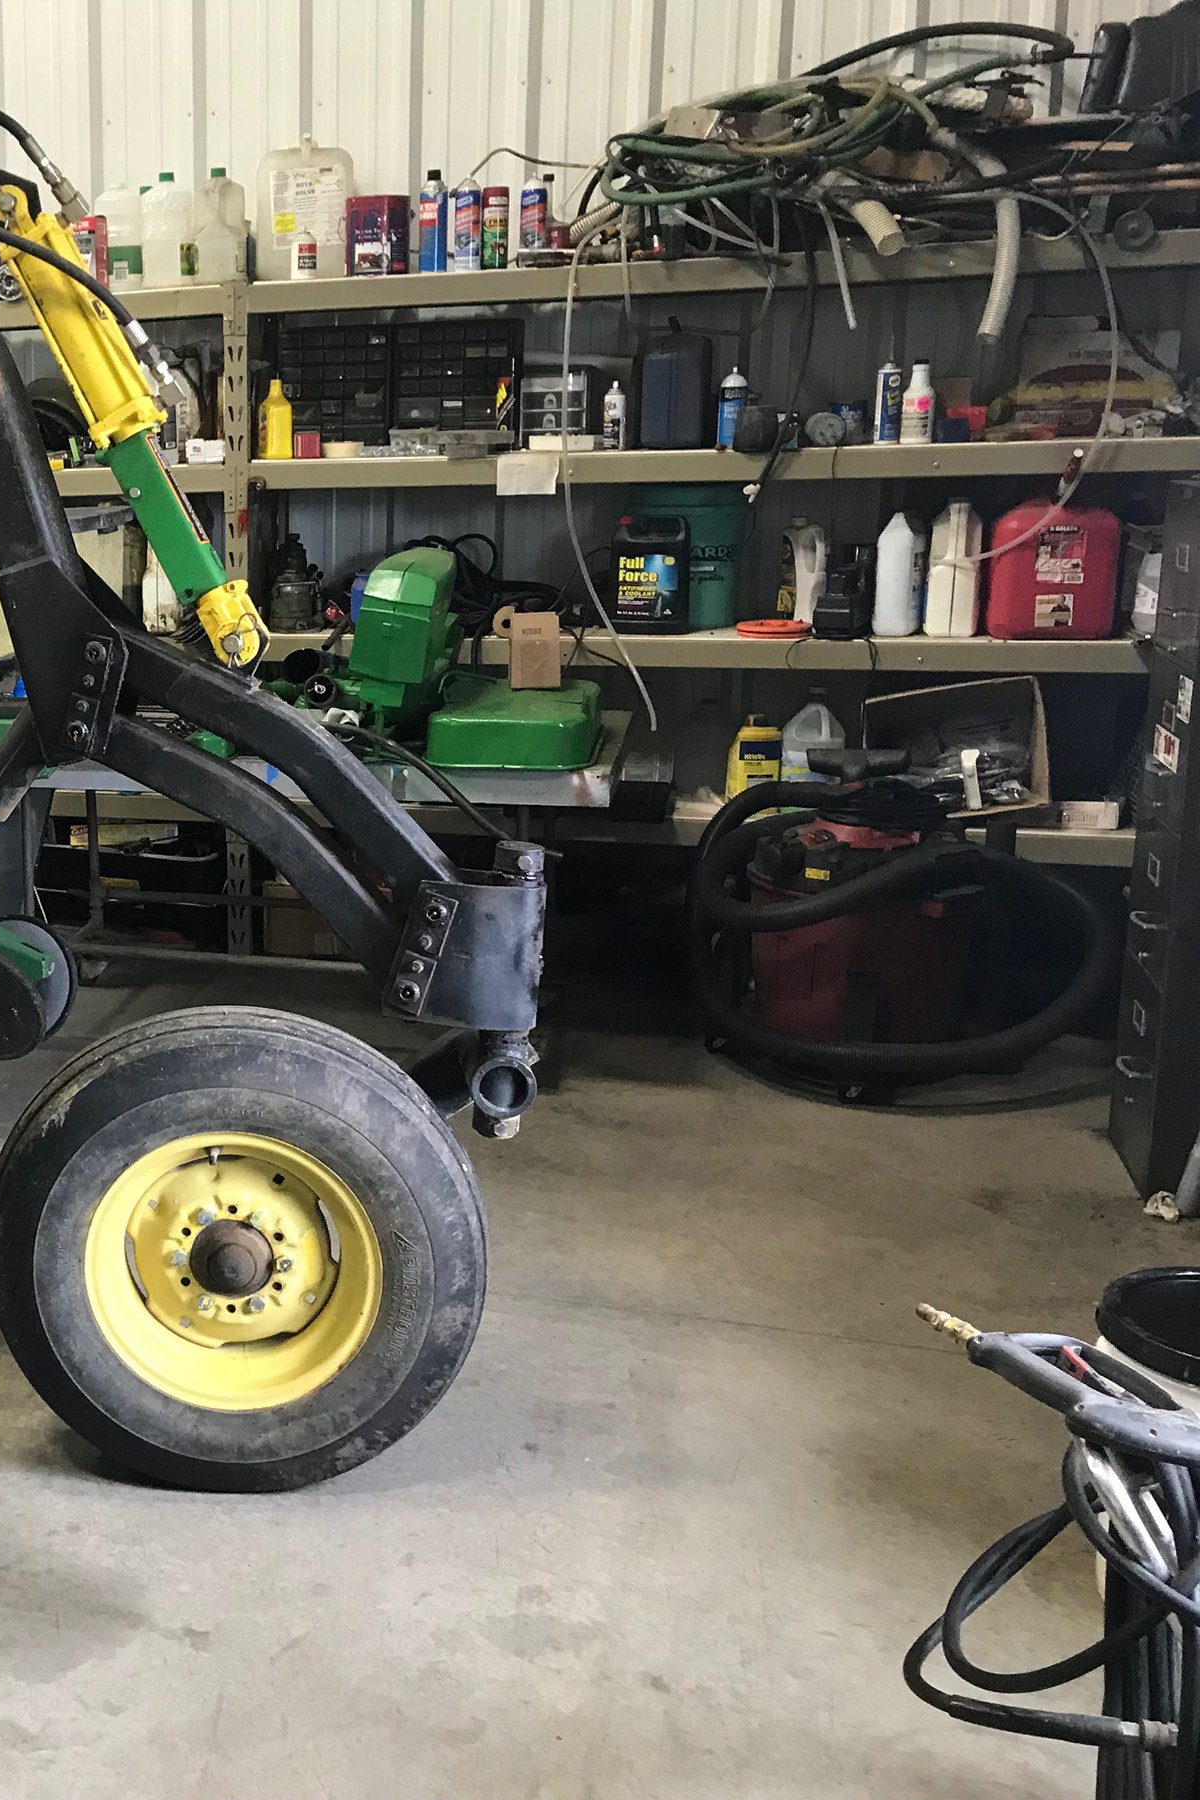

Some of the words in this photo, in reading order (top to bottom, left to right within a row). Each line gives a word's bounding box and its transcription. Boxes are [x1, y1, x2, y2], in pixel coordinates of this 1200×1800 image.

[619, 556, 645, 569] Full
[618, 570, 658, 582] Force
[385, 1229, 418, 1360] ARMSTRONG
